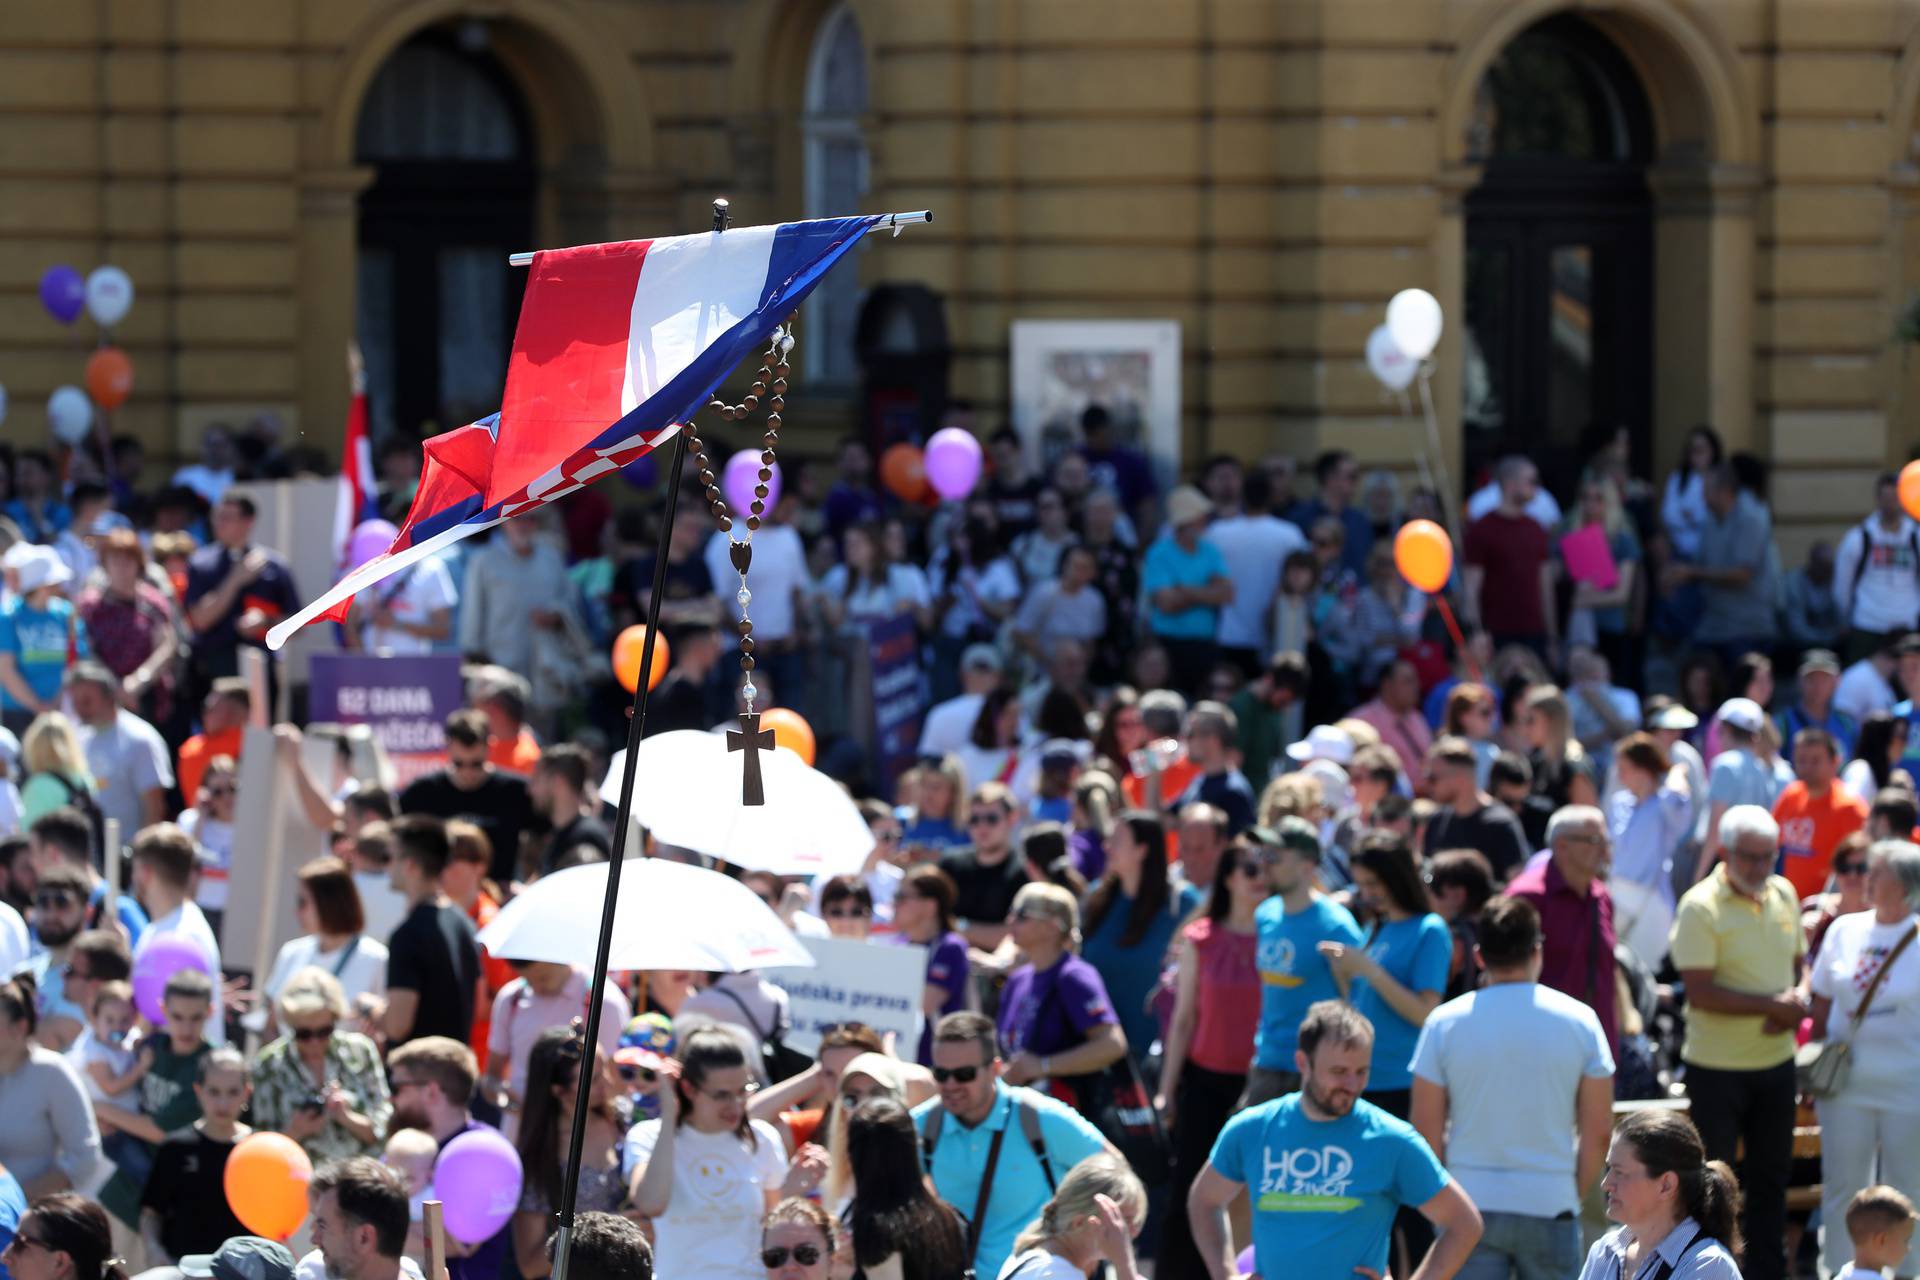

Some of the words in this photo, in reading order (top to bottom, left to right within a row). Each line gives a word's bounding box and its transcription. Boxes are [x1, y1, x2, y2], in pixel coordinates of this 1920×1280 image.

[369, 686, 433, 716] DANA
[373, 718, 446, 751] AČEĆA
[848, 989, 910, 1012] prava
[1263, 1146, 1353, 1183] HOD
[1259, 1177, 1288, 1193] ZA
